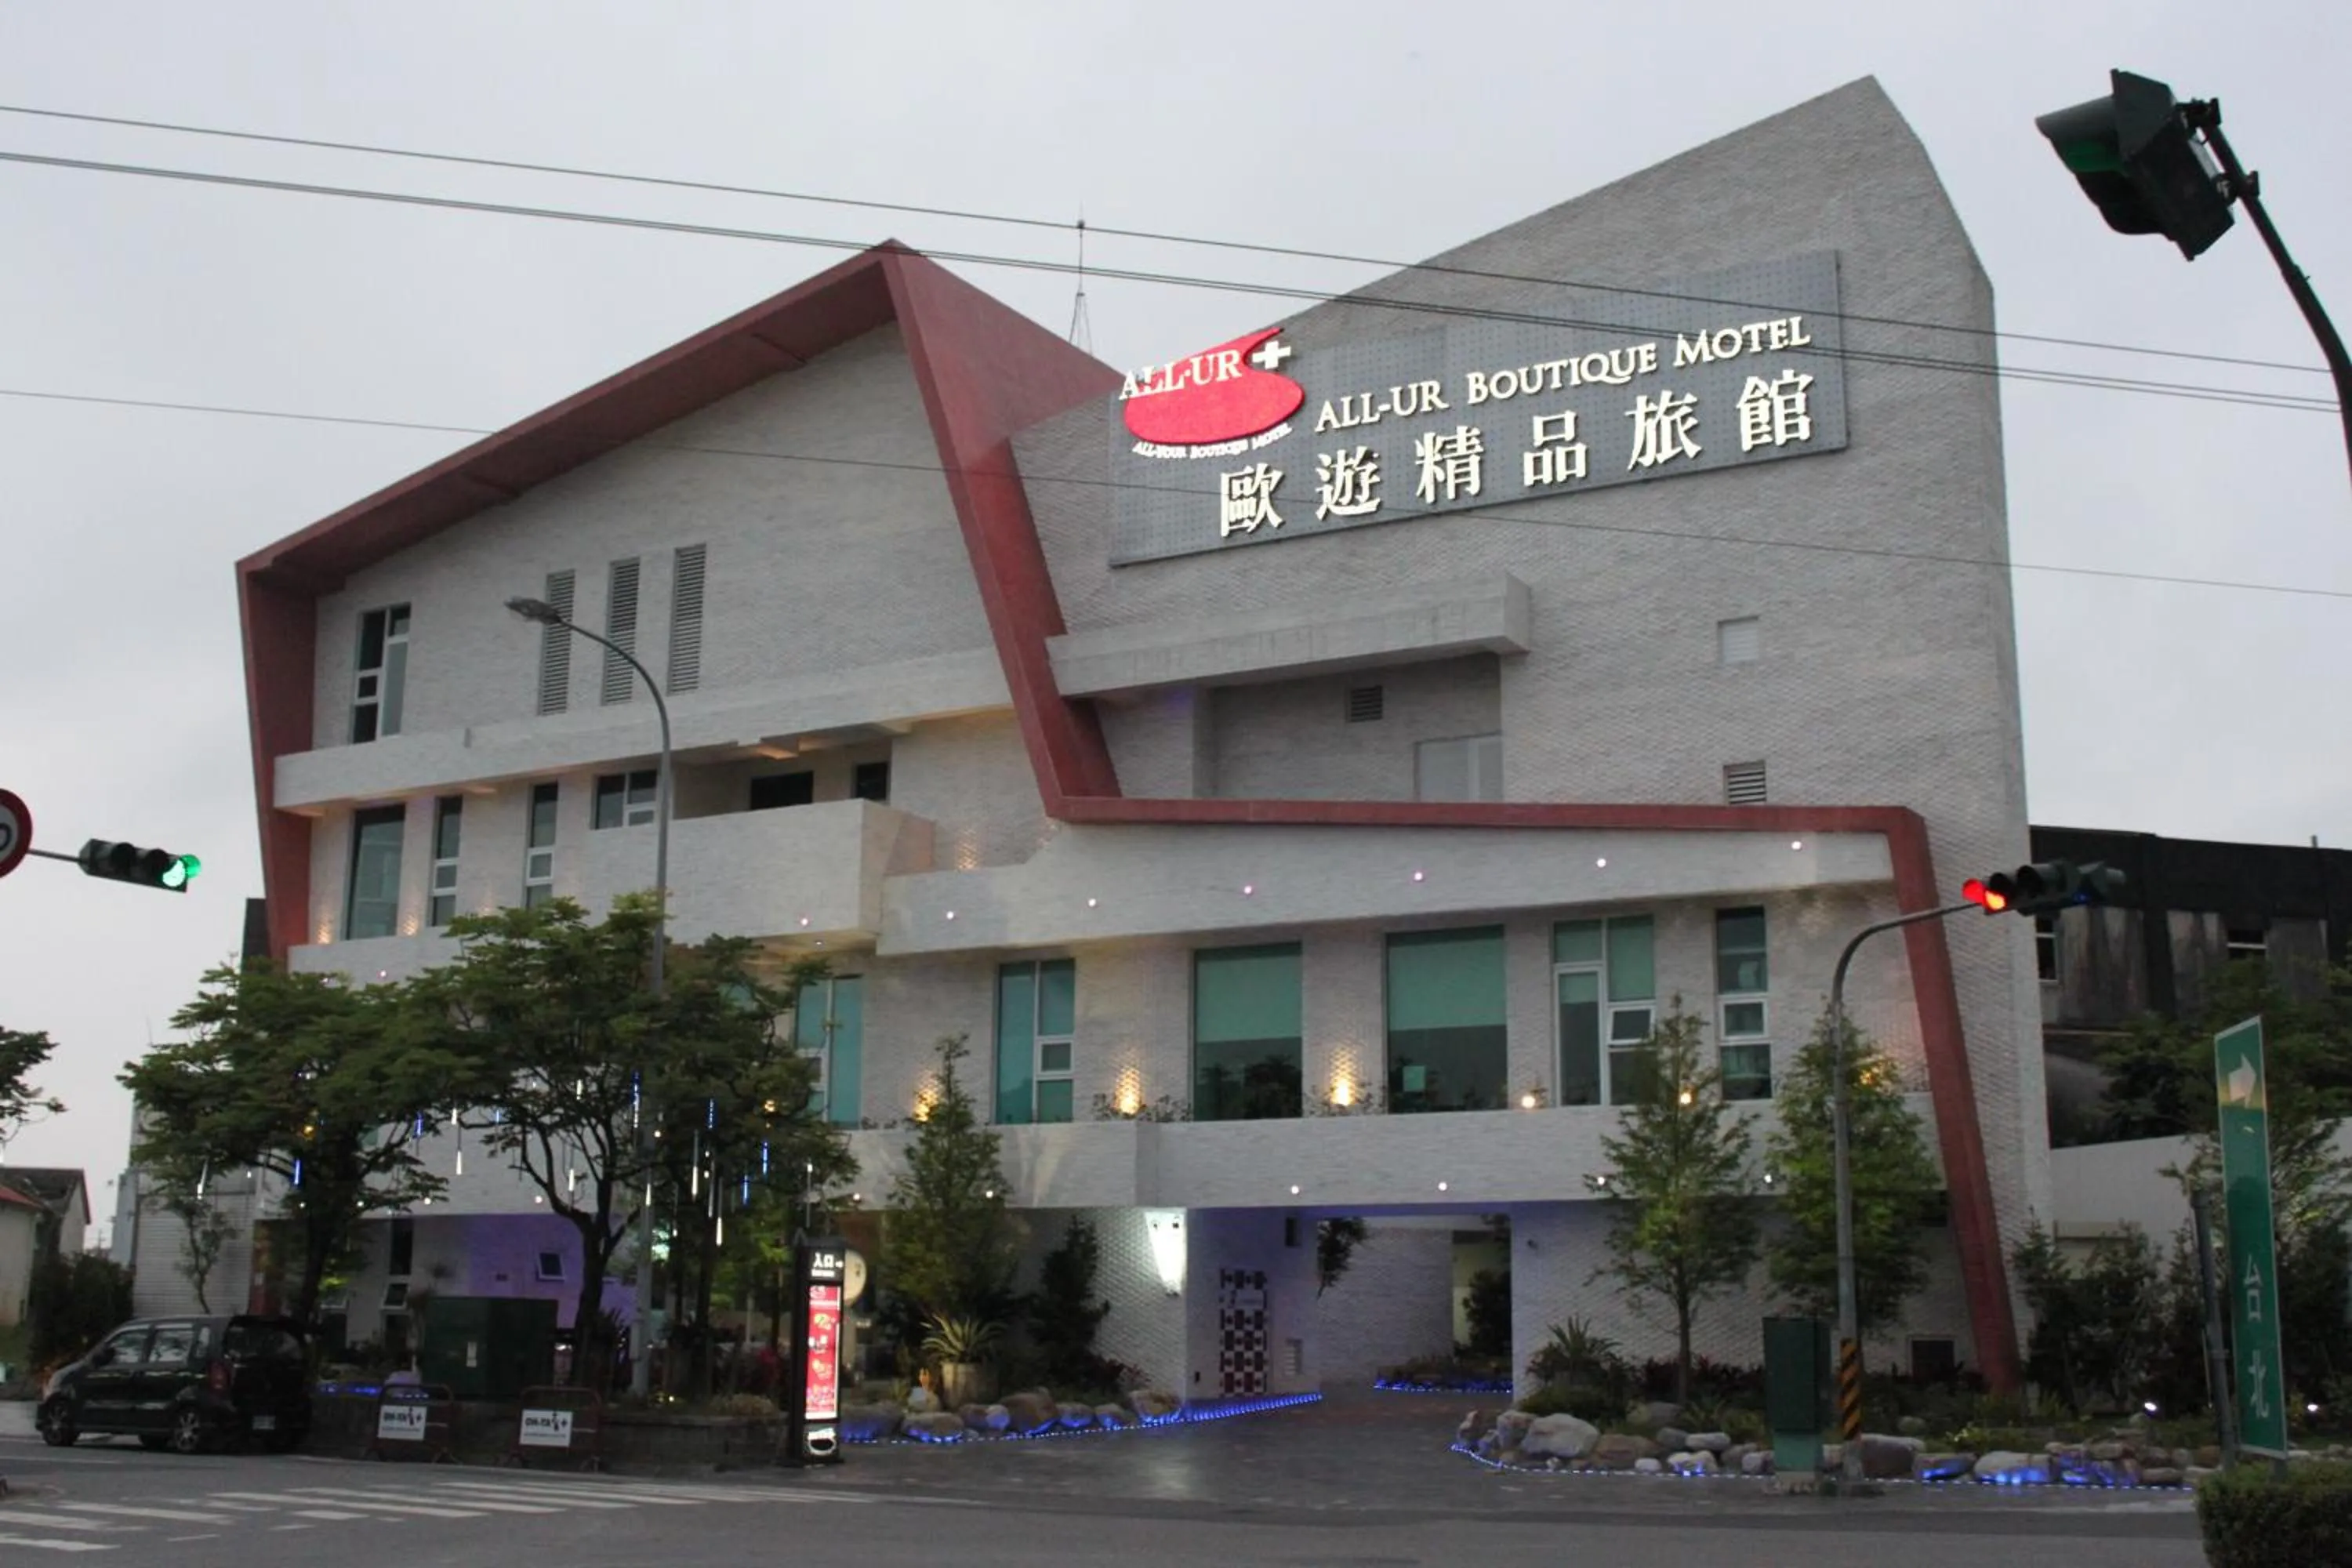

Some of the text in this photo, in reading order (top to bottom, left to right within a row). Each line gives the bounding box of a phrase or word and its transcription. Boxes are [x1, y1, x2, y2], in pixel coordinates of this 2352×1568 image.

[1314, 316, 1812, 433] ALL-UR BOUTIQUE MOTEL
[1220, 369, 1814, 538] 歐遊精品旅館
